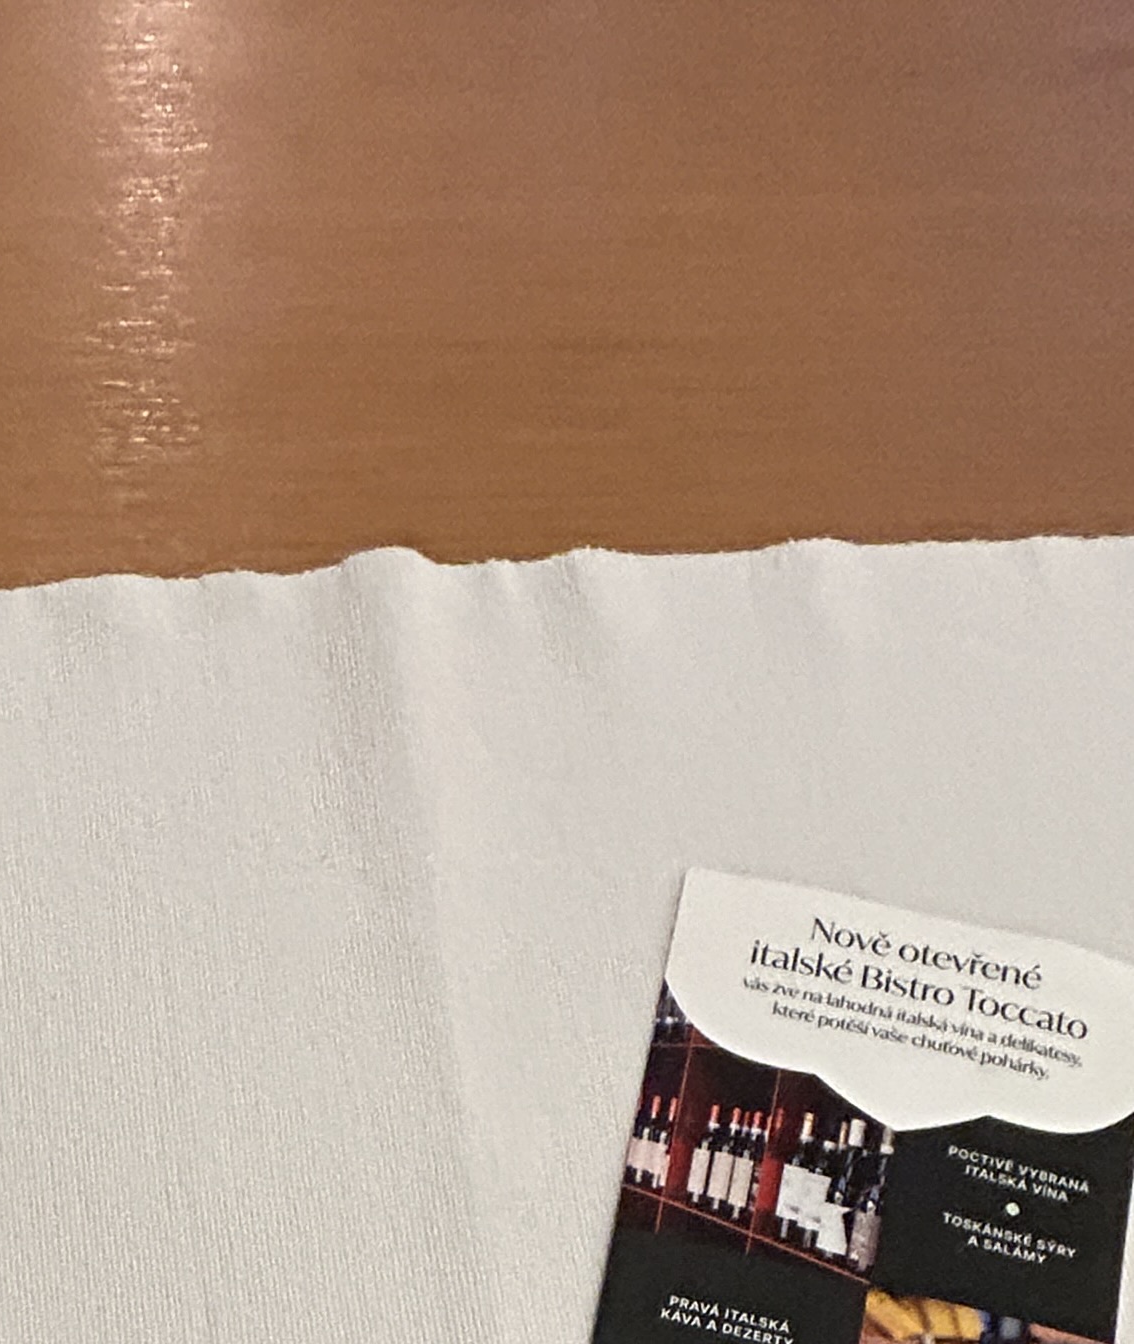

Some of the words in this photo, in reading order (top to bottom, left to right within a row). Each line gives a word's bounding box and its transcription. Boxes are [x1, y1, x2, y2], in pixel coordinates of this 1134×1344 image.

[811, 917, 892, 956] Nově
[899, 943, 1042, 990] otevřené
[743, 976, 769, 992] vás
[773, 984, 800, 1000] zve
[803, 990, 822, 1004] na
[826, 992, 892, 1018] lahodná
[896, 1010, 948, 1032] italská
[952, 1021, 983, 1041] vína
[987, 1031, 997, 1044] a
[751, 940, 853, 984] italské
[861, 965, 954, 1005] Bistro
[962, 985, 1088, 1039] Toccato
[772, 1001, 815, 1023] které
[817, 1013, 867, 1034] potěší
[871, 1024, 908, 1043] vaše
[912, 1034, 978, 1060] chuťové
[965, 1164, 1027, 1191] ITALSKÁ
[1032, 1183, 1069, 1203] VÍNA
[1018, 1164, 1089, 1194] VYBRANÁ
[942, 1211, 1032, 1247] TOSKÁNSKÉ
[1036, 1239, 1076, 1259] SÝRY
[967, 1235, 978, 1247] A
[983, 1239, 1047, 1264] SALÁMY
[660, 1307, 701, 1328] KÁVA
[706, 1320, 717, 1331] A
[669, 1295, 720, 1317] PRAVÁ
[724, 1308, 790, 1333] ITALSKÁ
